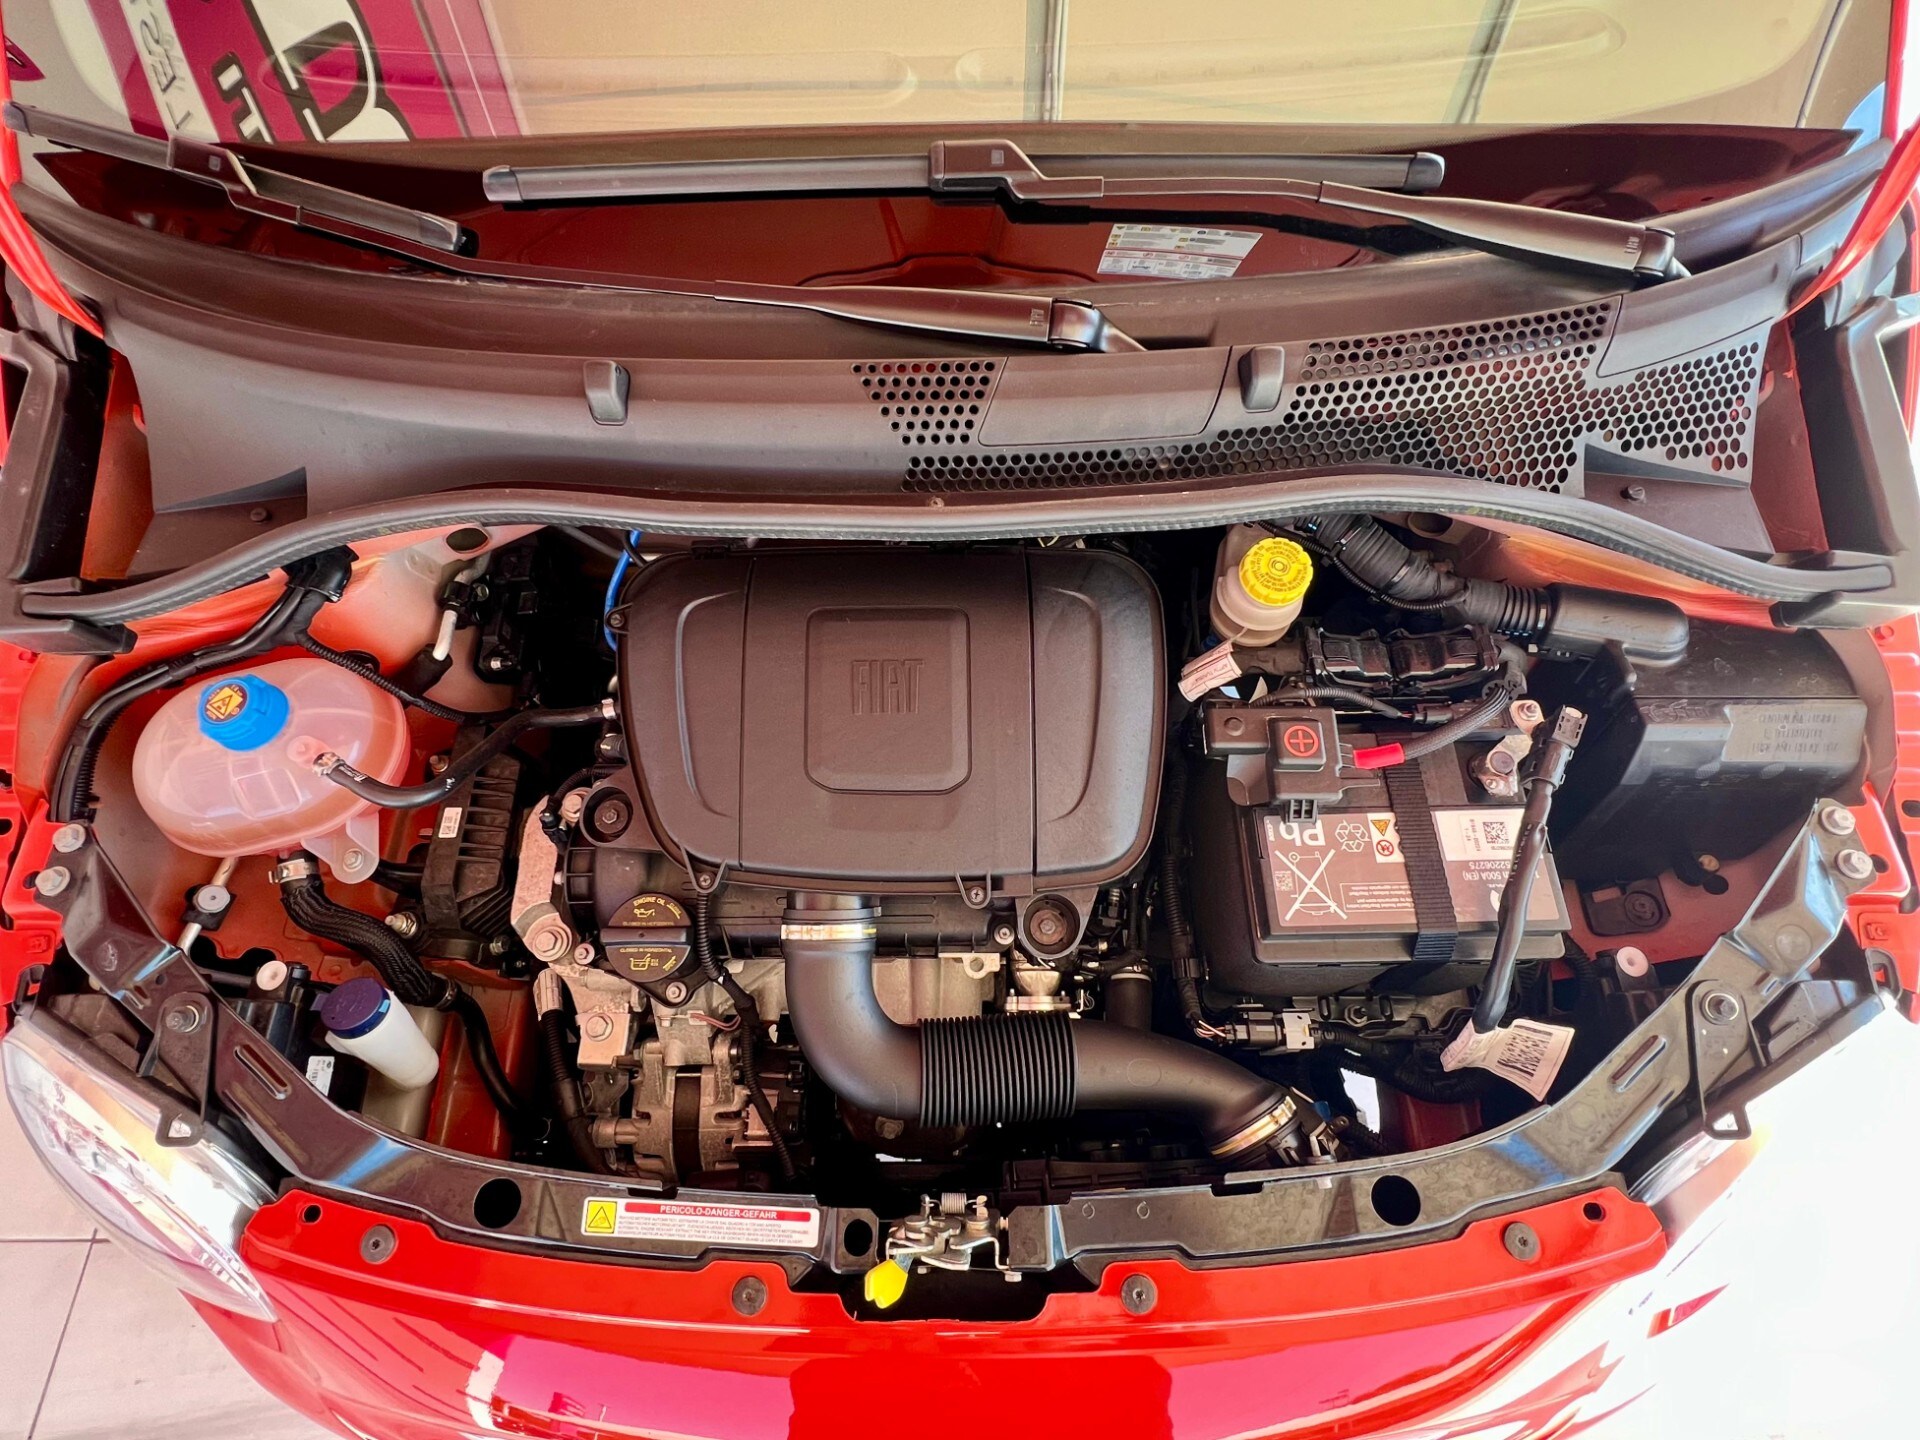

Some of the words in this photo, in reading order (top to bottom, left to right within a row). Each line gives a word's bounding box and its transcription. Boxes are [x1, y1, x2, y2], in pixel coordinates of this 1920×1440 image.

[851, 658, 925, 715] FIAT
[1279, 819, 1326, 847] Pb
[1480, 870, 1502, 881] 500A
[632, 896, 656, 907] ENGINE
[656, 897, 666, 907] OIL
[659, 1204, 778, 1220] PERICOLO-DANGER-GEFAHR
